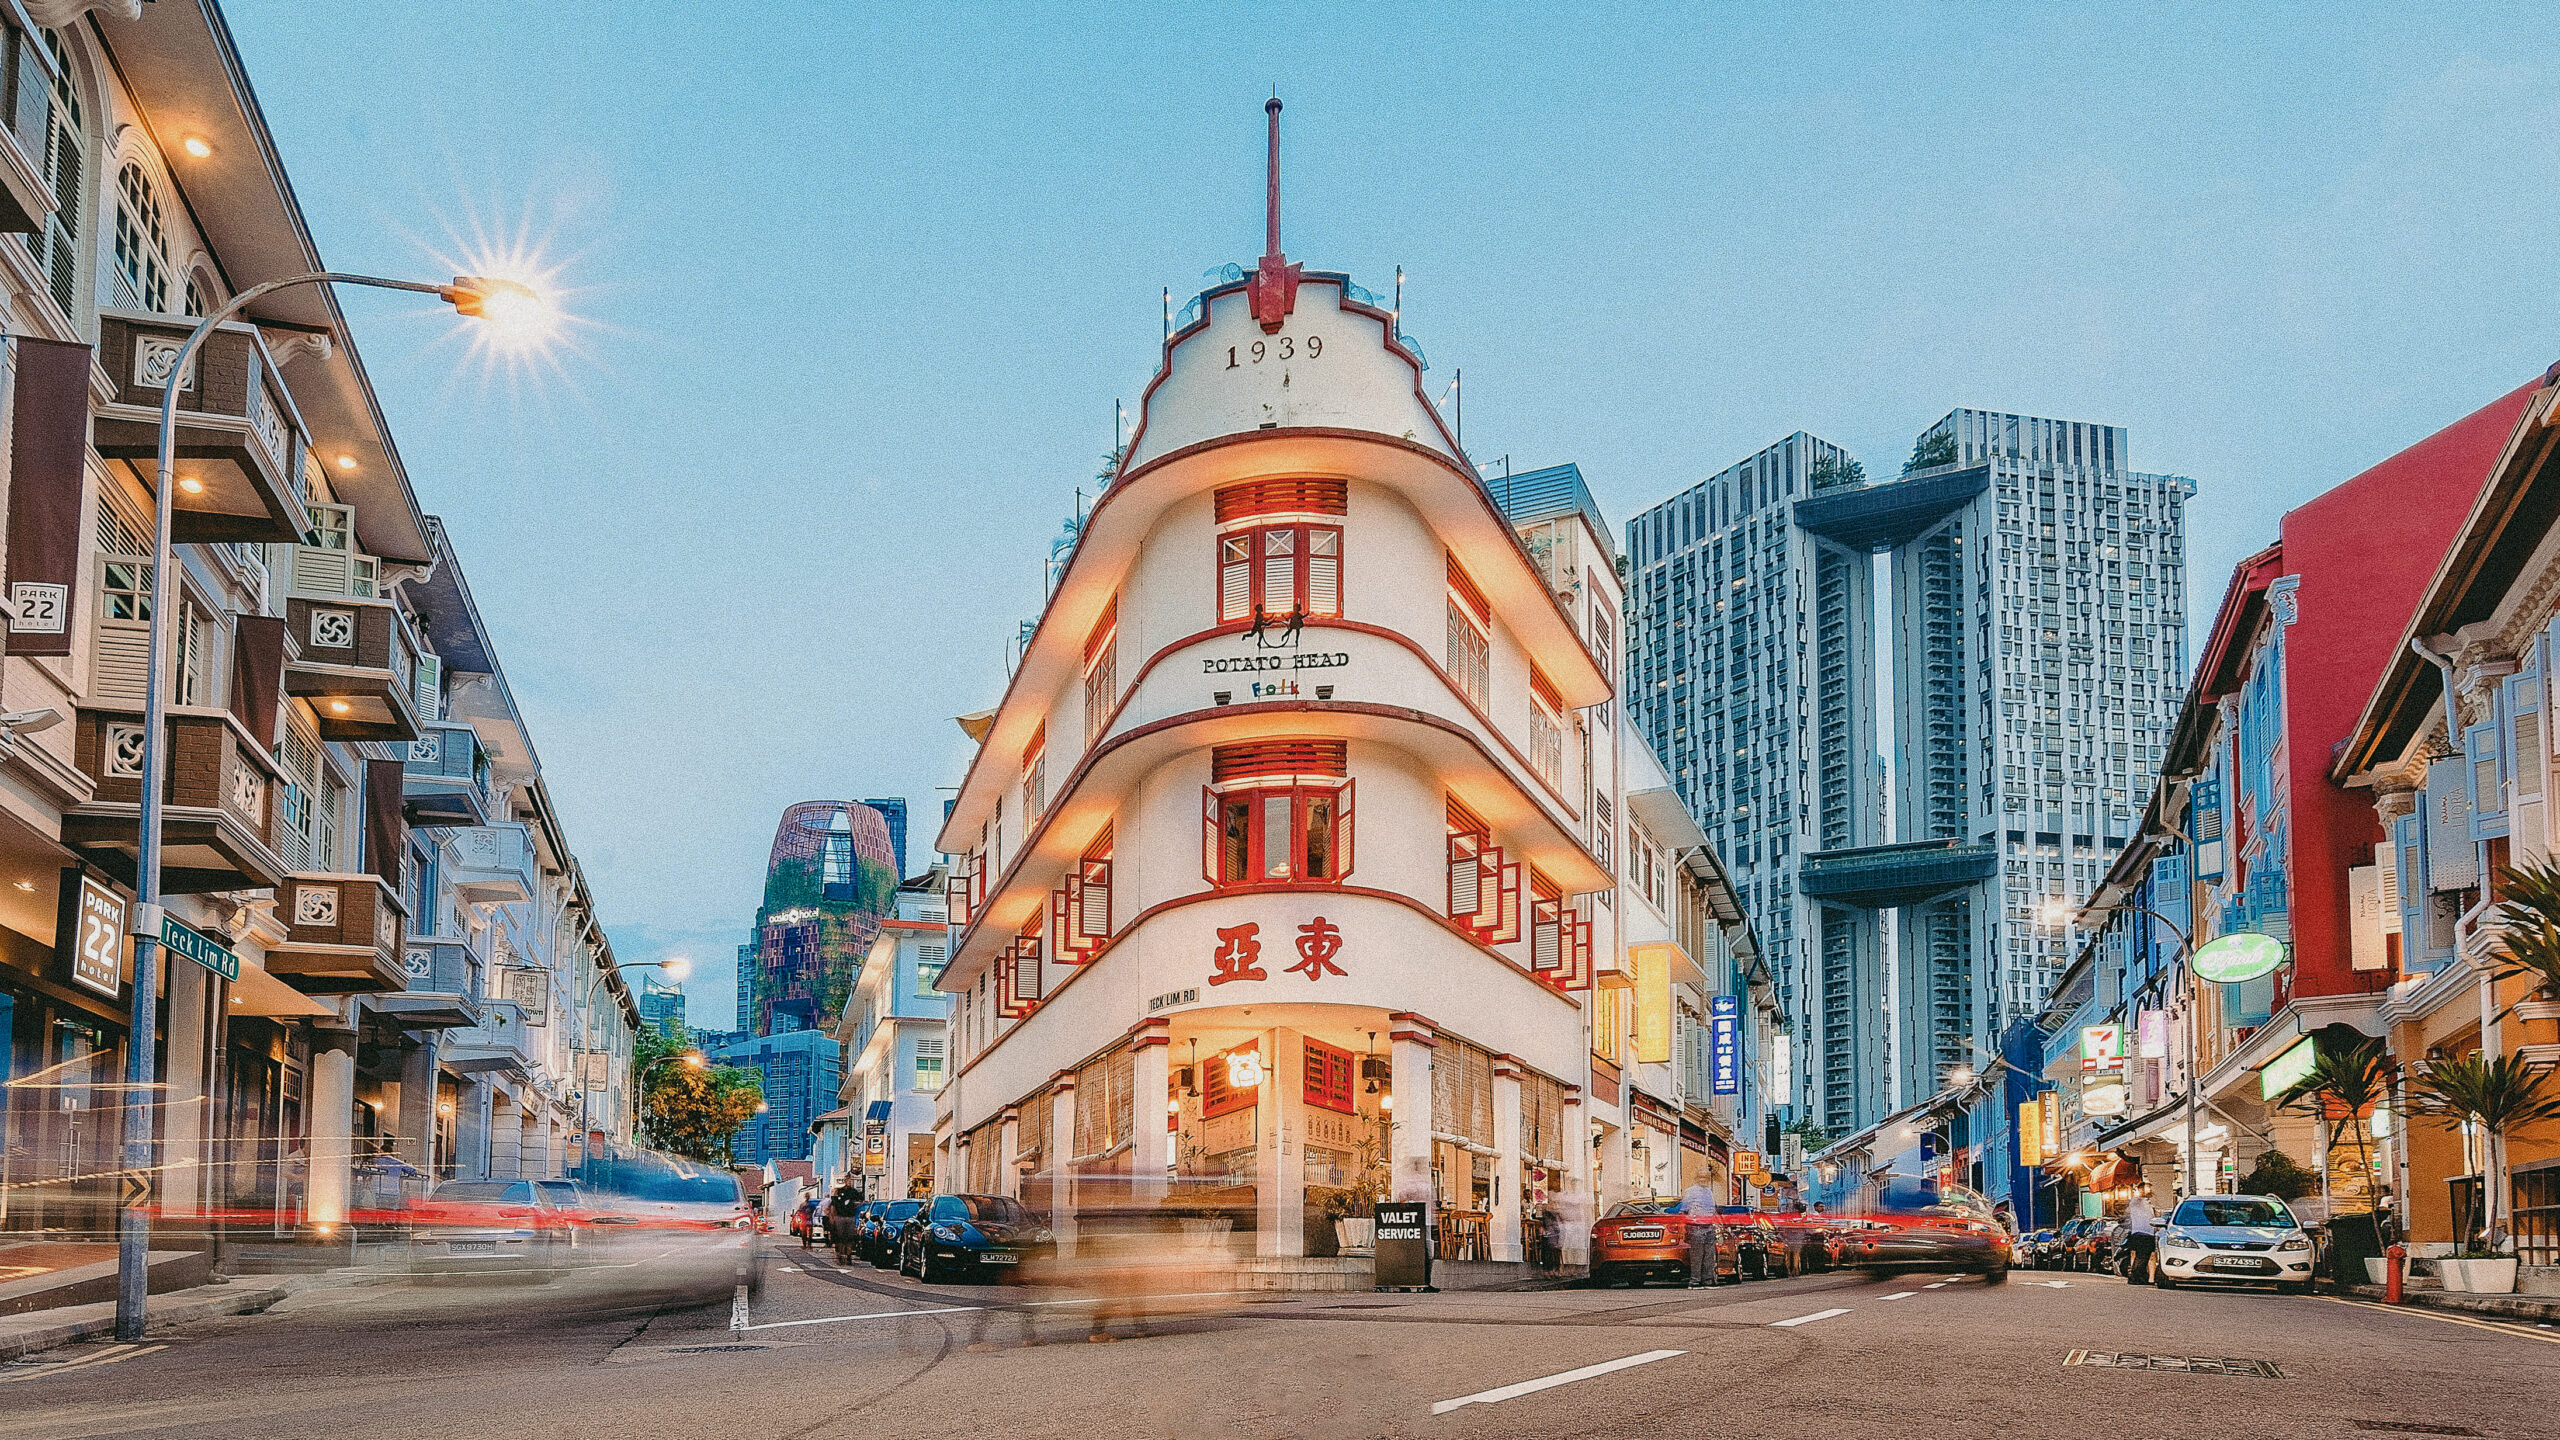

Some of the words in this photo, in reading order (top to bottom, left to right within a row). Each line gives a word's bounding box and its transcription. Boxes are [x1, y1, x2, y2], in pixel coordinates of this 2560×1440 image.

[1225, 335, 1323, 370] 1939
[20, 590, 57, 598] PARK
[22, 599, 54, 619] 22
[1203, 656, 1281, 673] POTATO
[1293, 652, 1349, 669] HEAD
[1252, 678, 1299, 697] Folk
[2450, 787, 2465, 828] LIORA
[86, 891, 120, 923] PARK
[84, 915, 116, 968] 22
[165, 920, 193, 955] Teck
[197, 939, 218, 968] Lim
[221, 952, 235, 977] Rd
[80, 959, 115, 984] hotel
[1150, 995, 1164, 1011] TECK
[1166, 991, 1180, 1006] LIM
[1184, 989, 1195, 1002] RD
[1741, 1154, 1755, 1162] IND
[1381, 1211, 1418, 1223] VALET
[1378, 1228, 1420, 1240] SERVICE
